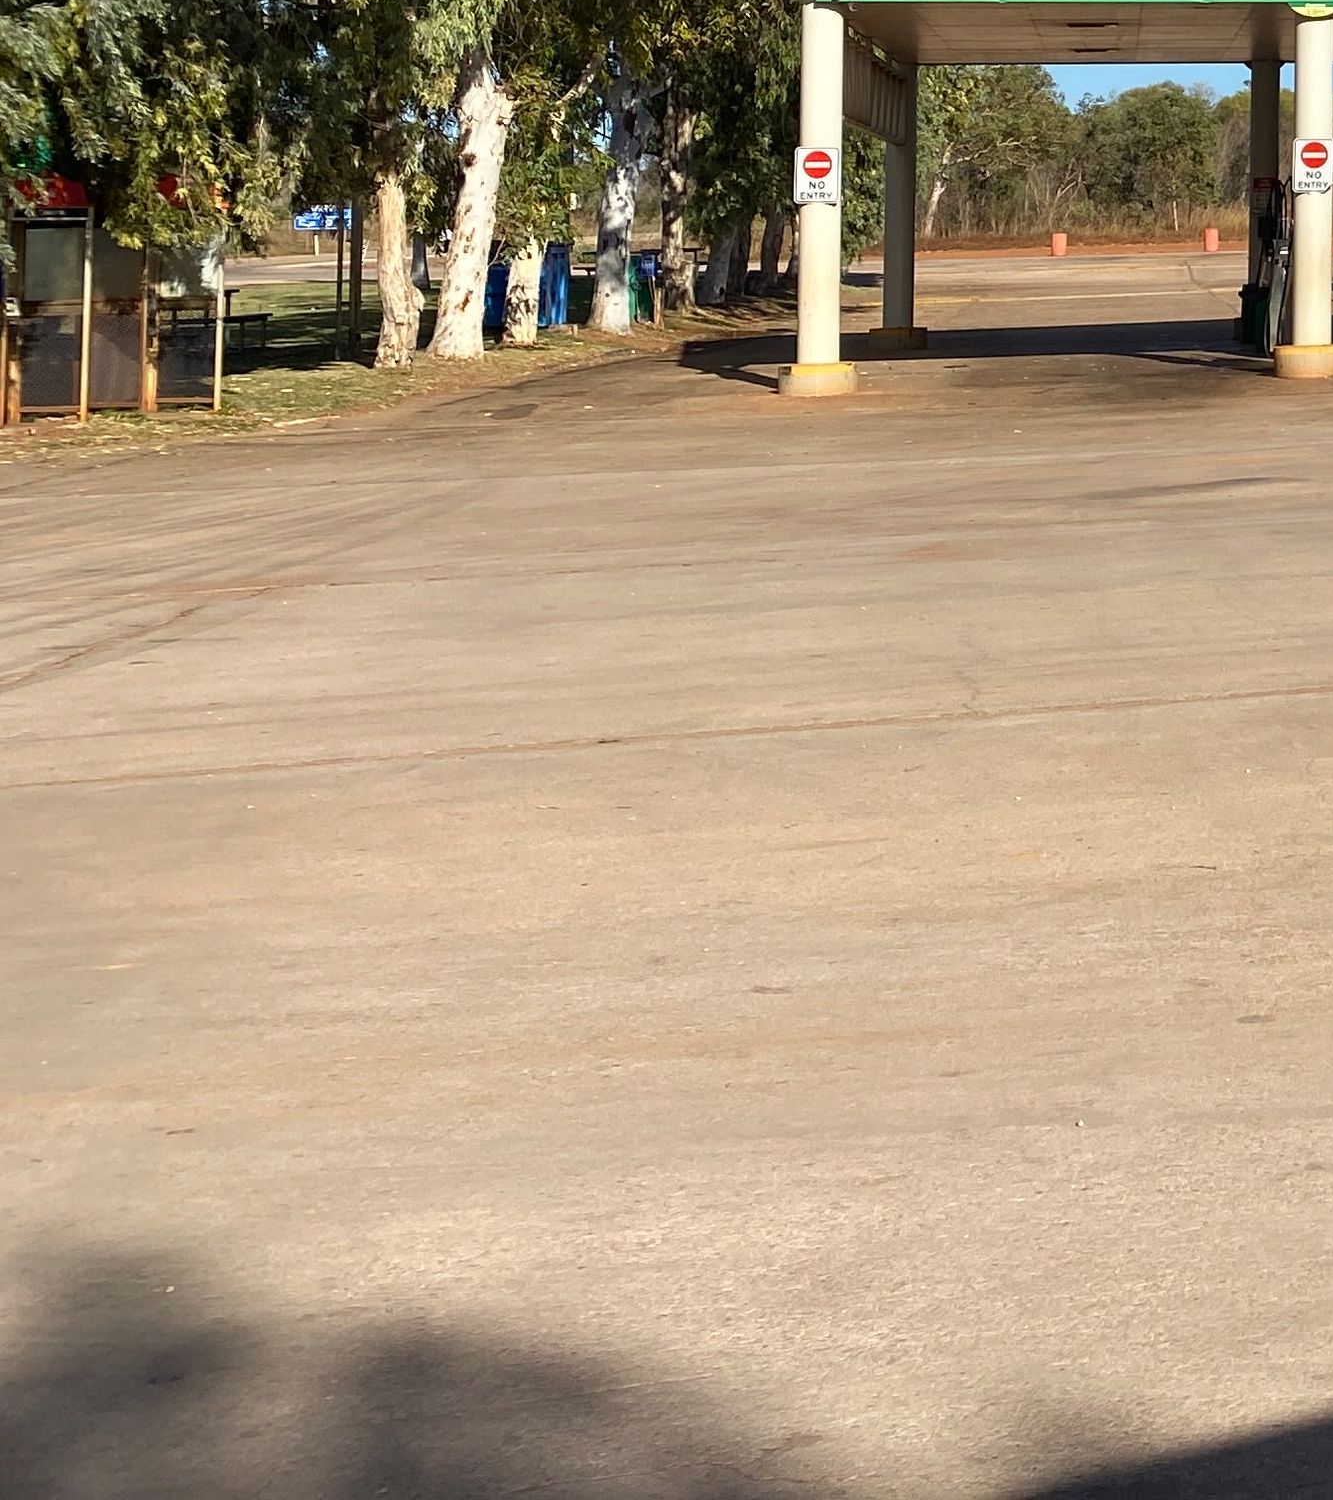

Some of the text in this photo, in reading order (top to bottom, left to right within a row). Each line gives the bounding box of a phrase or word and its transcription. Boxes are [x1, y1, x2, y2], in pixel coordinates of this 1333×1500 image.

[1306, 171, 1322, 179] NO
[809, 181, 825, 189] NO
[1298, 181, 1328, 189] ENTRY
[800, 192, 832, 200] ENTRY
